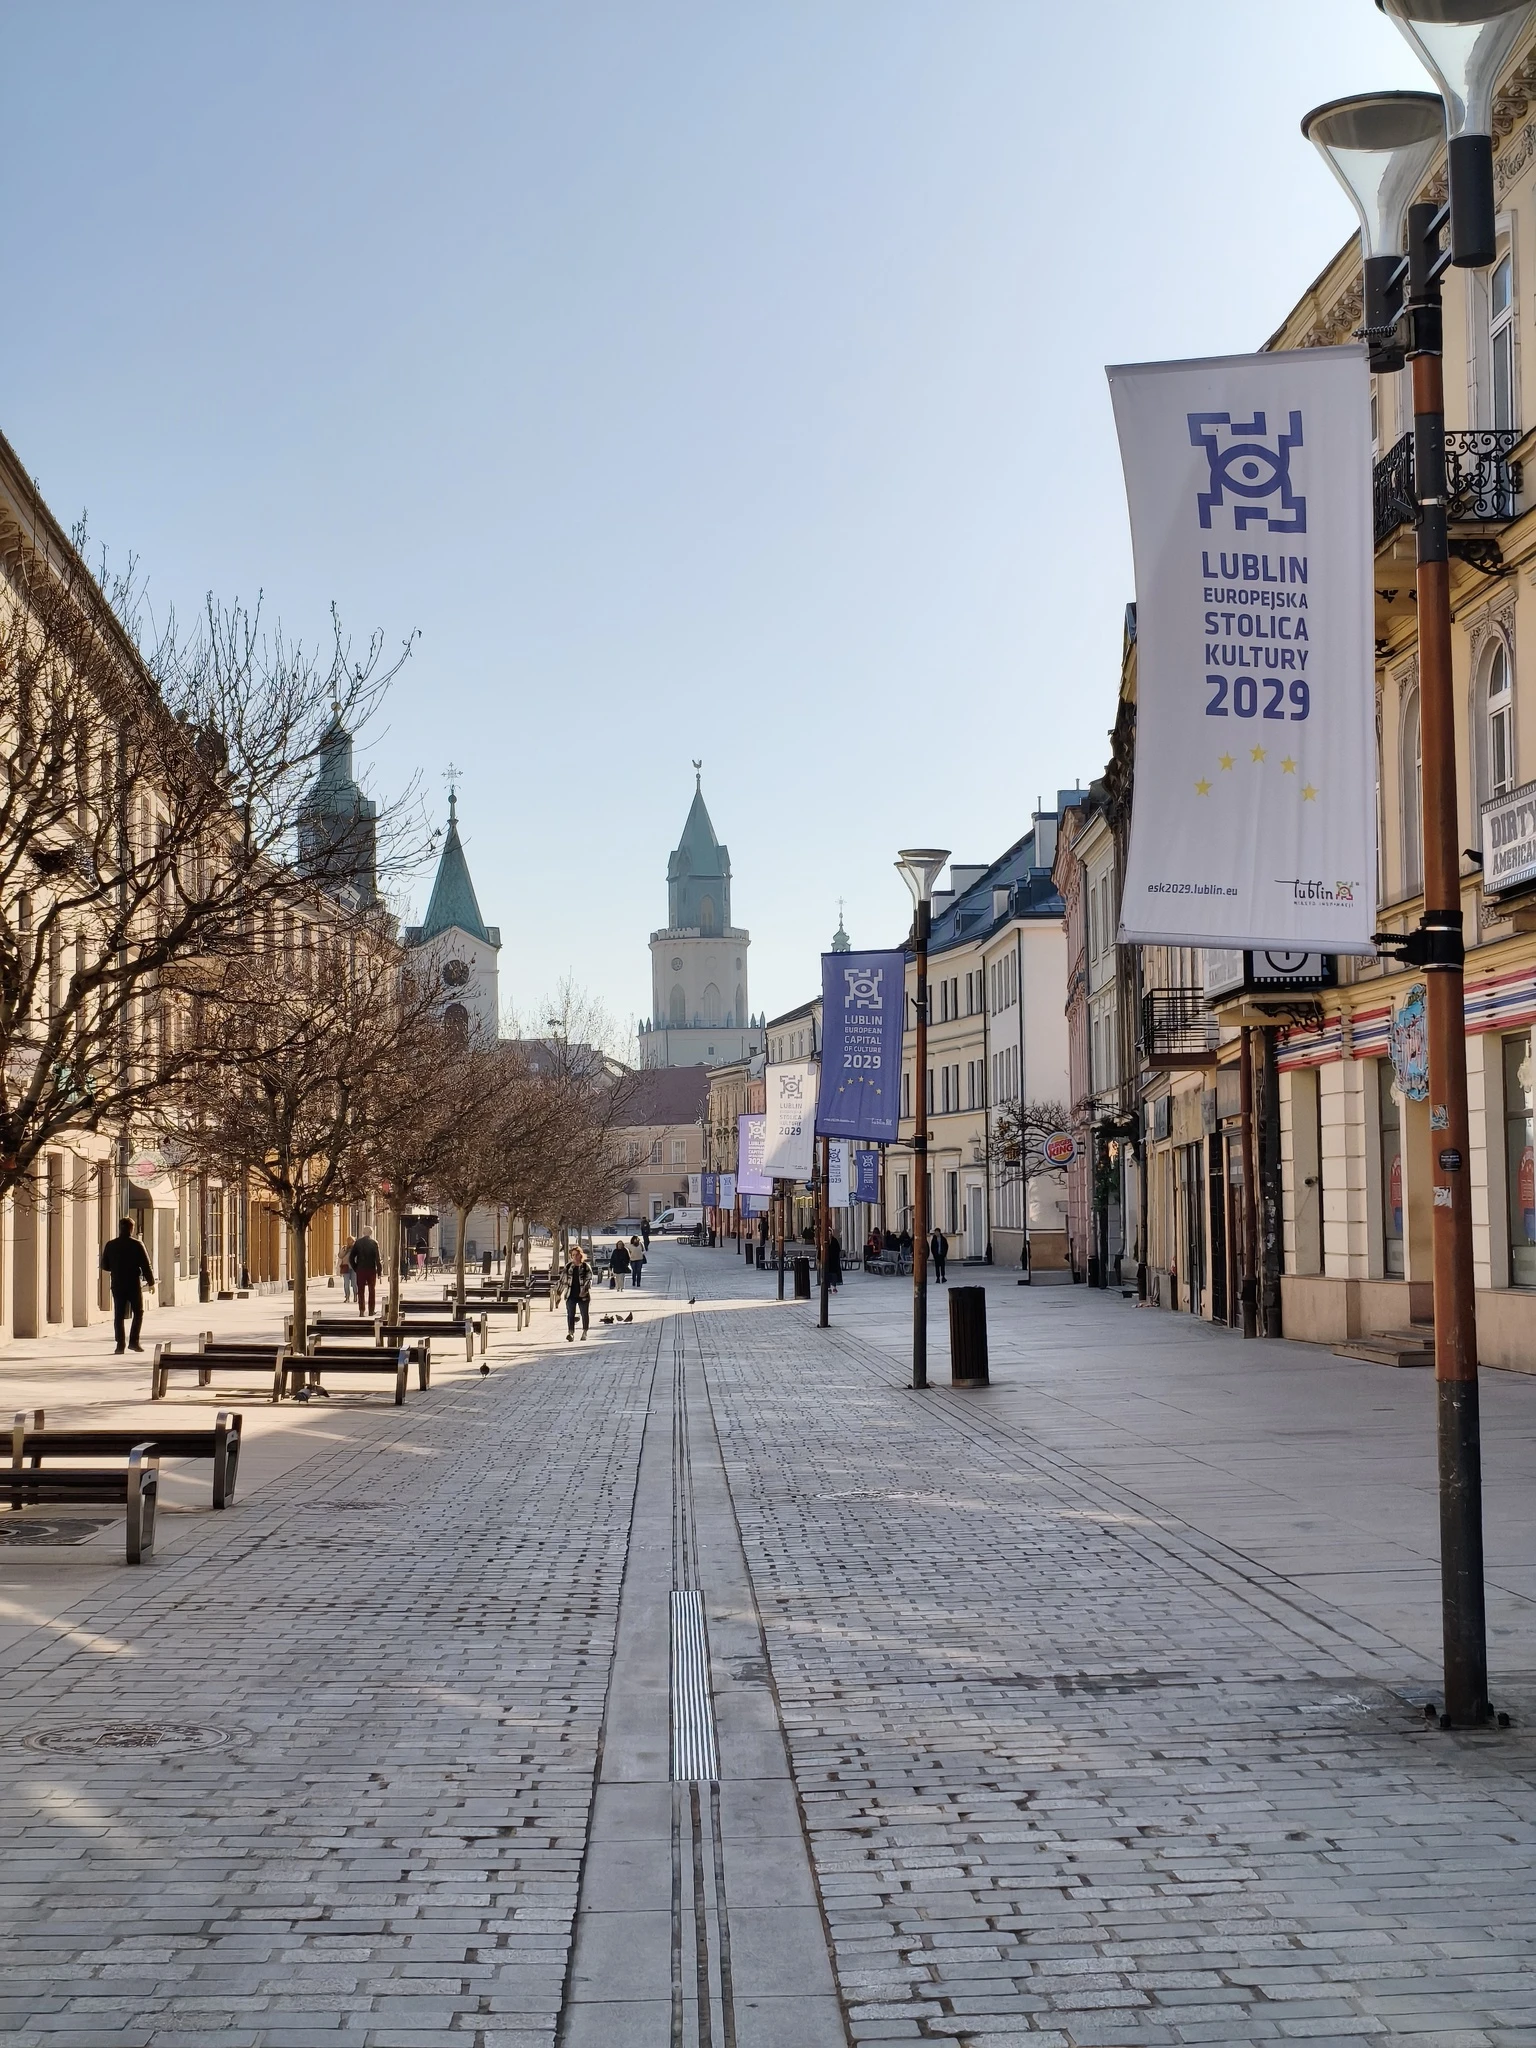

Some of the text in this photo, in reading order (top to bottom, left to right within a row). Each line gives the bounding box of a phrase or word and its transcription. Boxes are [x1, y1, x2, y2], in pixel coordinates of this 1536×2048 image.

[1202, 551, 1308, 584] LUBLIN
[1203, 587, 1308, 610] EUROPEJSKA
[1205, 611, 1309, 641] STOLICA
[1205, 643, 1309, 671] KULTURY
[1205, 674, 1310, 721] 2029
[1147, 883, 1238, 896] esk2029.lublin.eu
[1274, 879, 1334, 900] lublin
[844, 1015, 883, 1025] LUBLIN
[844, 1026, 883, 1034] EUROPEAN
[844, 1035, 882, 1045] CAPITAL
[853, 1045, 882, 1053] CULTURE
[843, 1054, 882, 1069] 2029
[778, 1126, 802, 1136] 2029
[1049, 1144, 1073, 1158] KING
